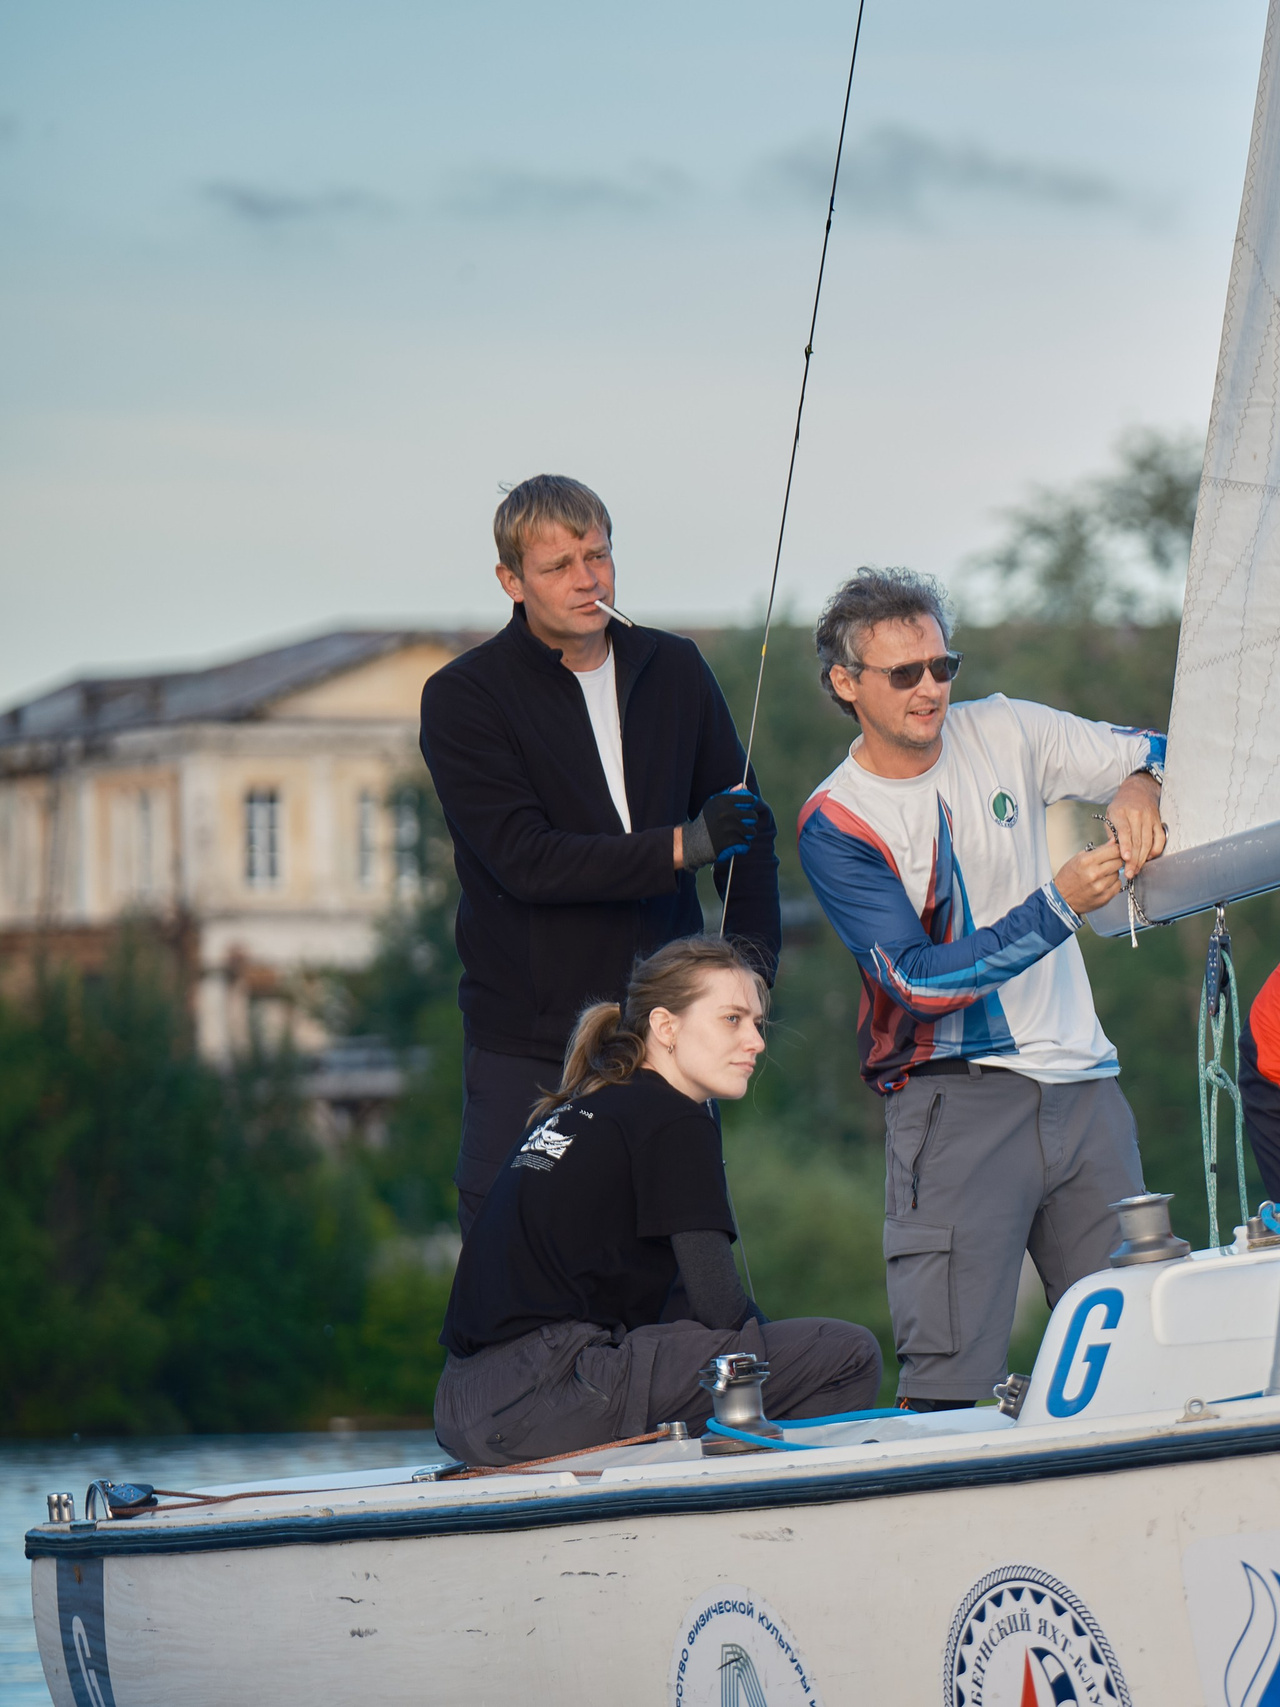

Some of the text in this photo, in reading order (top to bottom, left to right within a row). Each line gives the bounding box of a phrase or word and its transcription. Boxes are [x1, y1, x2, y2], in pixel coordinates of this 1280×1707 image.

[1046, 1287, 1125, 1418] G
[687, 1600, 754, 1646] ФИЗИЧЕСКОЙ
[758, 1612, 811, 1694] КУЛЬТУРЫ
